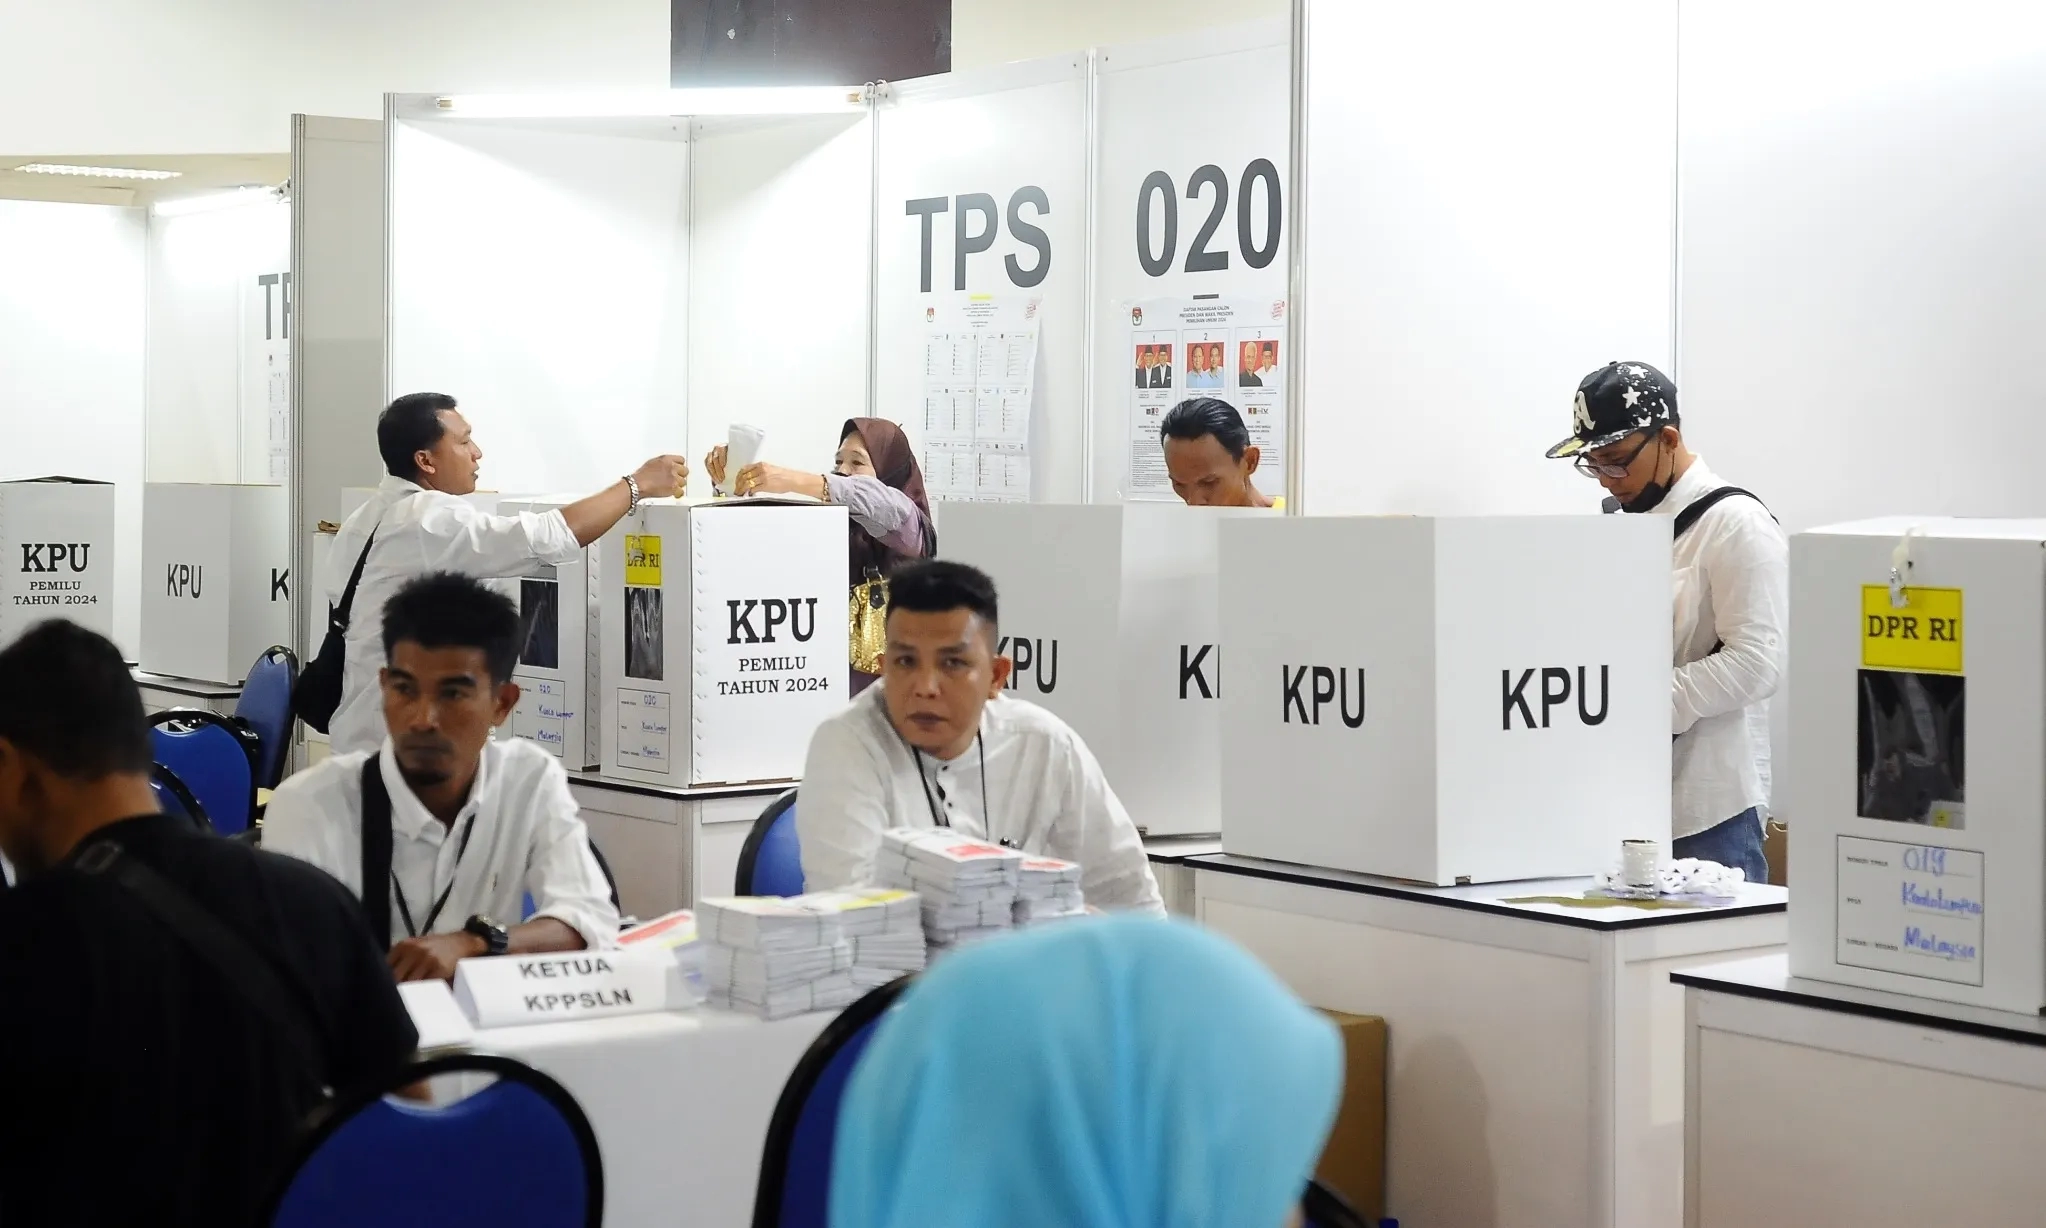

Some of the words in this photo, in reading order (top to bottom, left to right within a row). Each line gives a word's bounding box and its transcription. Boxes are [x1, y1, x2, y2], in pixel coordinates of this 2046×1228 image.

[1136, 158, 1282, 278] 020
[906, 185, 1052, 293] TPS
[1203, 332, 1208, 341] 2
[1257, 330, 1262, 339] 3
[21, 543, 90, 573] KPU
[648, 553, 659, 568] RI
[29, 581, 81, 591] PEMILU
[167, 563, 202, 599] KPU
[13, 595, 60, 606] TAHUN
[64, 595, 98, 605] 2024
[726, 597, 818, 645] KPU
[1868, 615, 1919, 640] DPR
[1929, 617, 1957, 642] RI
[738, 656, 807, 672] PEMILU
[1179, 644, 1221, 700] K
[717, 680, 779, 696] TAHUN
[786, 677, 829, 692] 2024
[1282, 664, 1365, 729] KPU
[1502, 664, 1609, 731] KPU
[519, 958, 613, 979] KETUA
[524, 988, 632, 1012] KPPSLN
